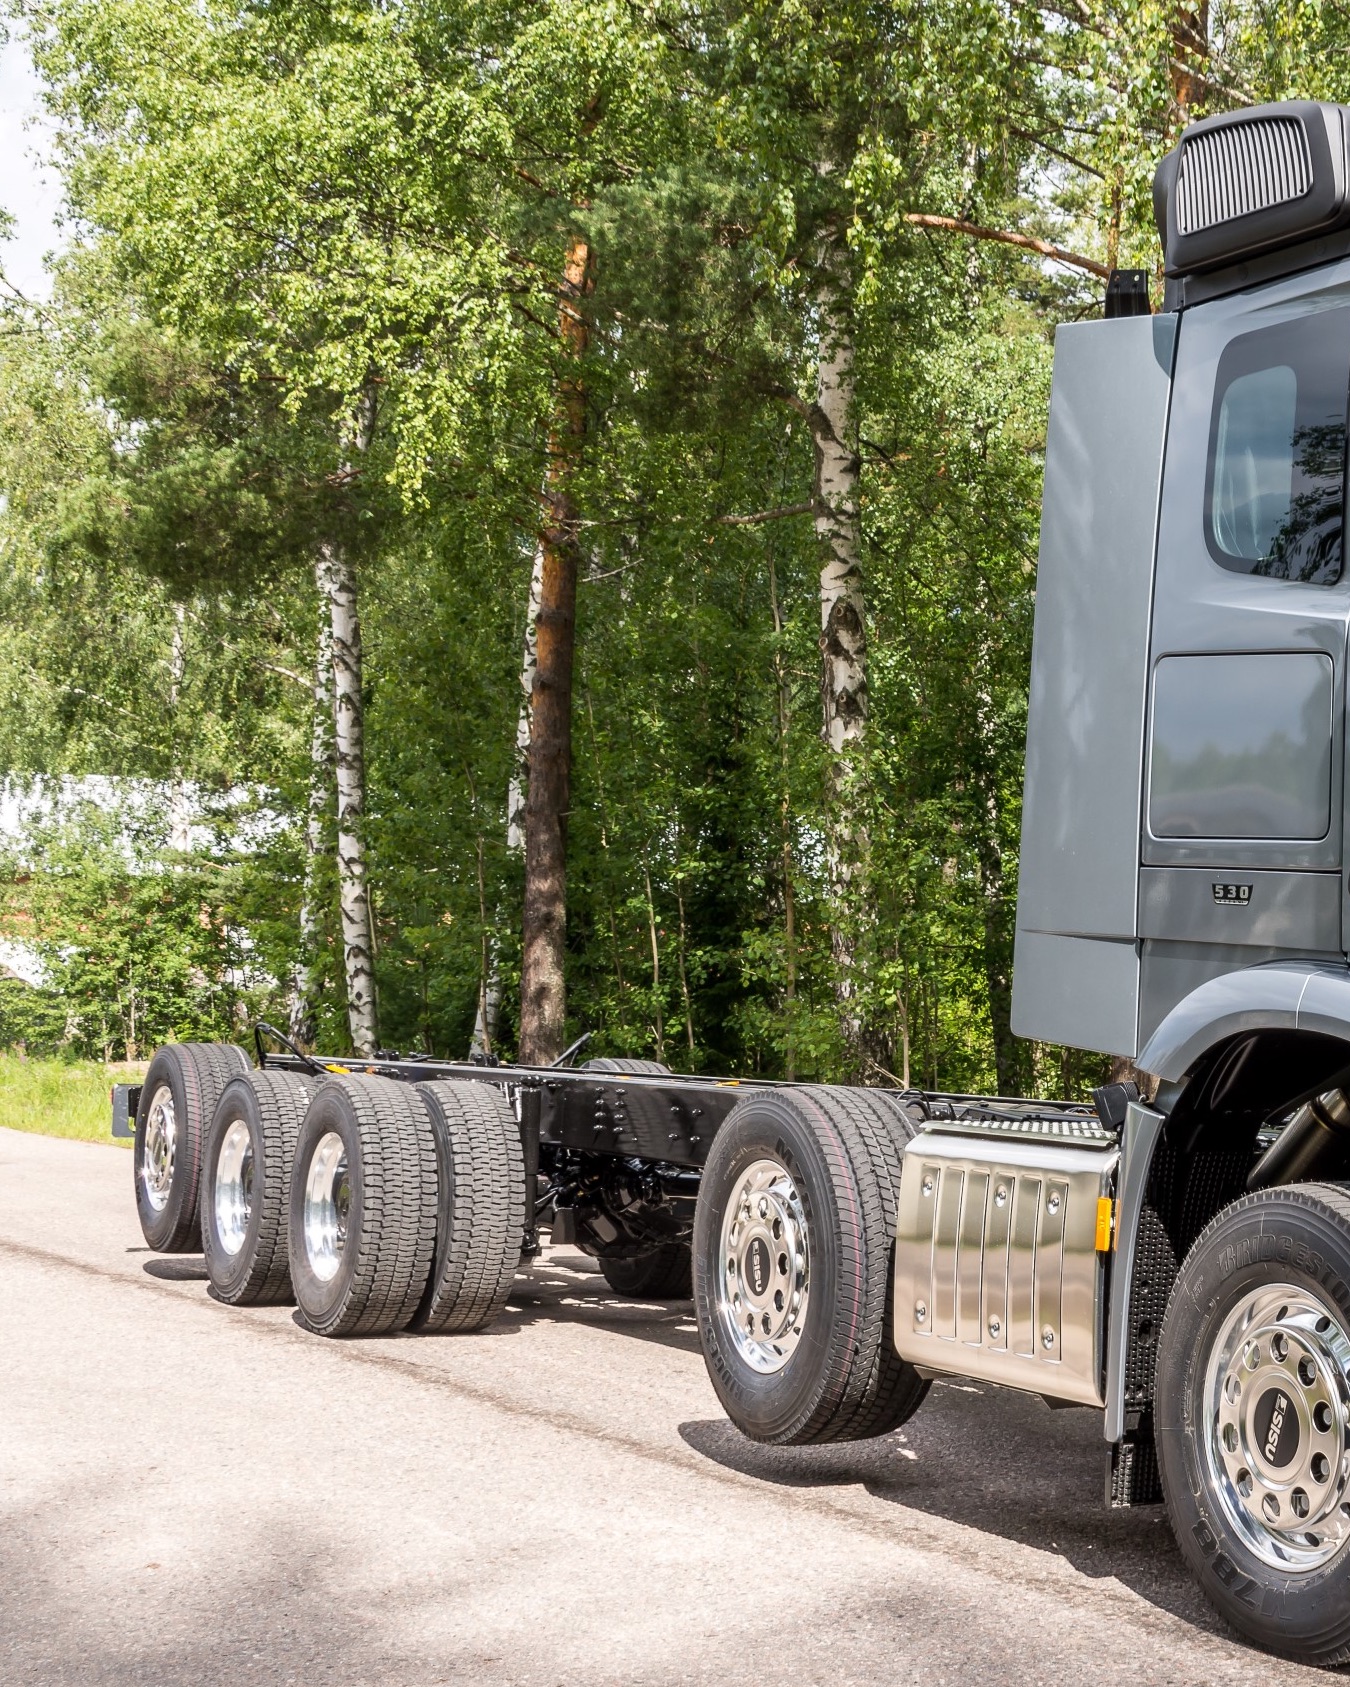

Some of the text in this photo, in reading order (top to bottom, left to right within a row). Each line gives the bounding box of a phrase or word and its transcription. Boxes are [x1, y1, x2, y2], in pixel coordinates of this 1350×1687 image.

[1215, 884, 1249, 899] 530
[753, 1254, 762, 1292] SISU
[1265, 1410, 1283, 1462] SISU
